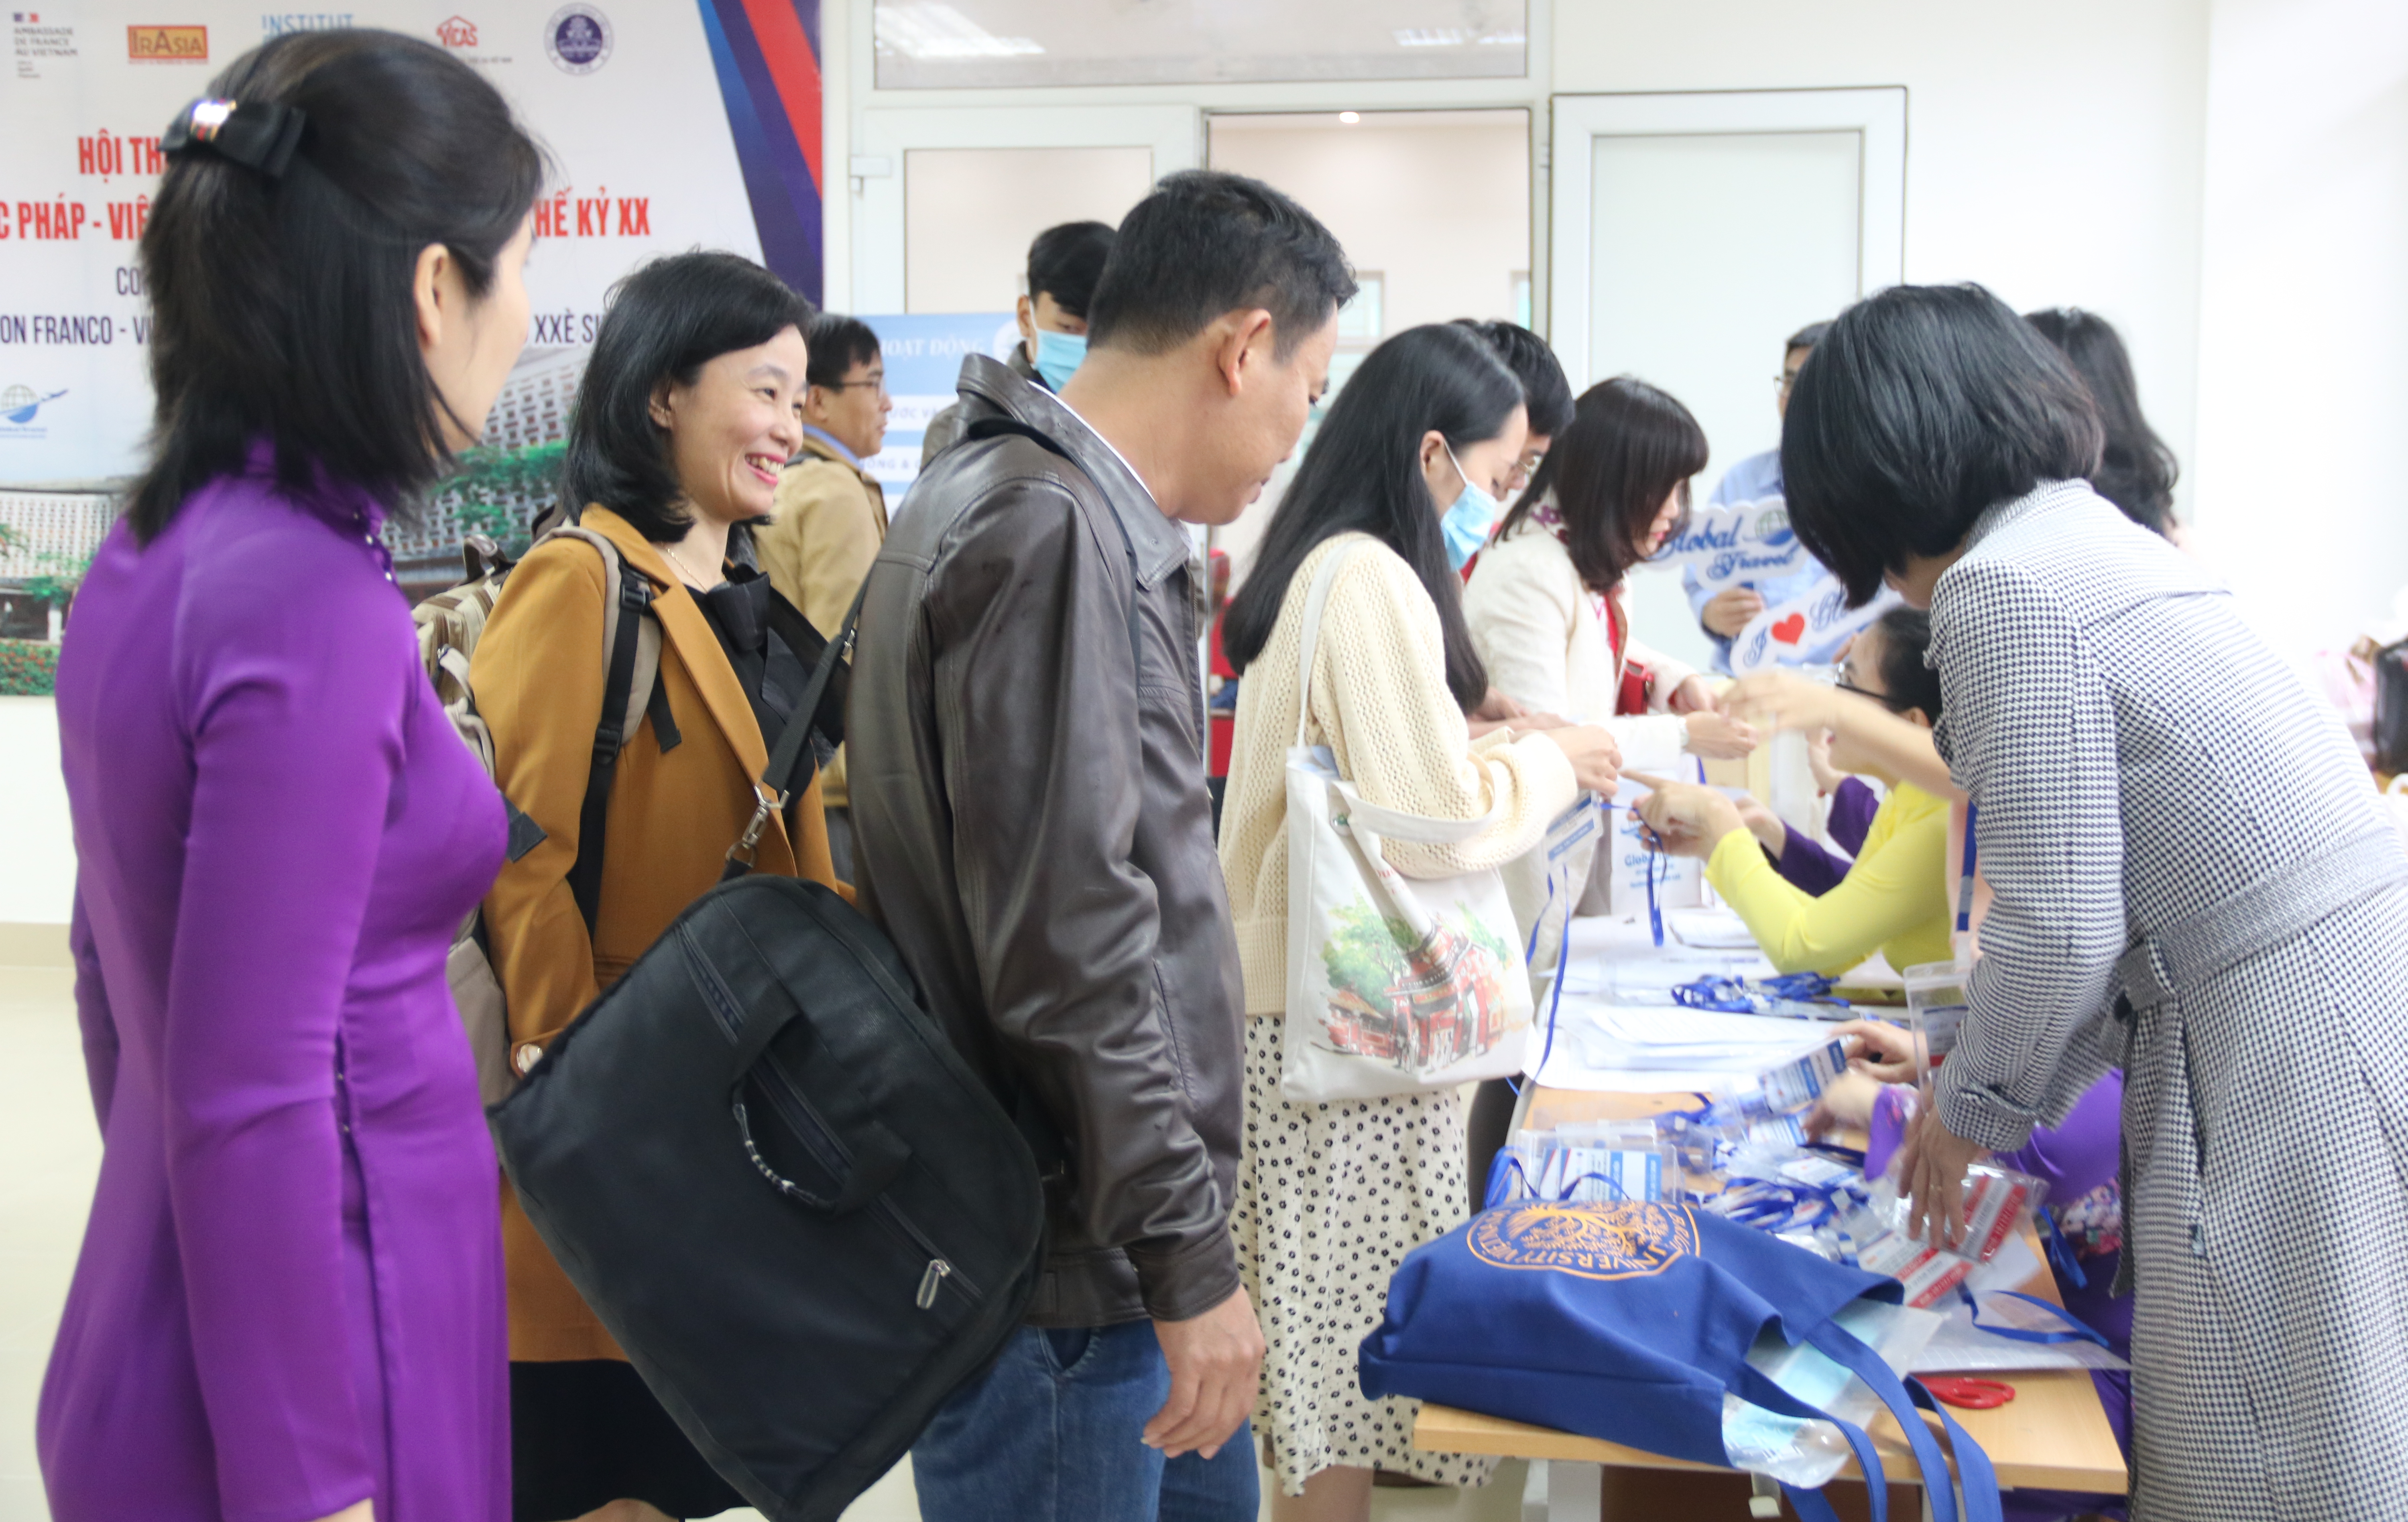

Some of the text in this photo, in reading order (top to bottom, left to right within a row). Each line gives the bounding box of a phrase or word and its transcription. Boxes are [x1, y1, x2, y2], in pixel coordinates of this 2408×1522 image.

[78, 128, 123, 183] HỘI
[18, 192, 85, 240] PHÁP
[533, 185, 651, 238] HẾ KỶ XX
[116, 266, 147, 296] CO
[34, 315, 112, 345] FRANCO
[535, 307, 575, 344] XXÈ
